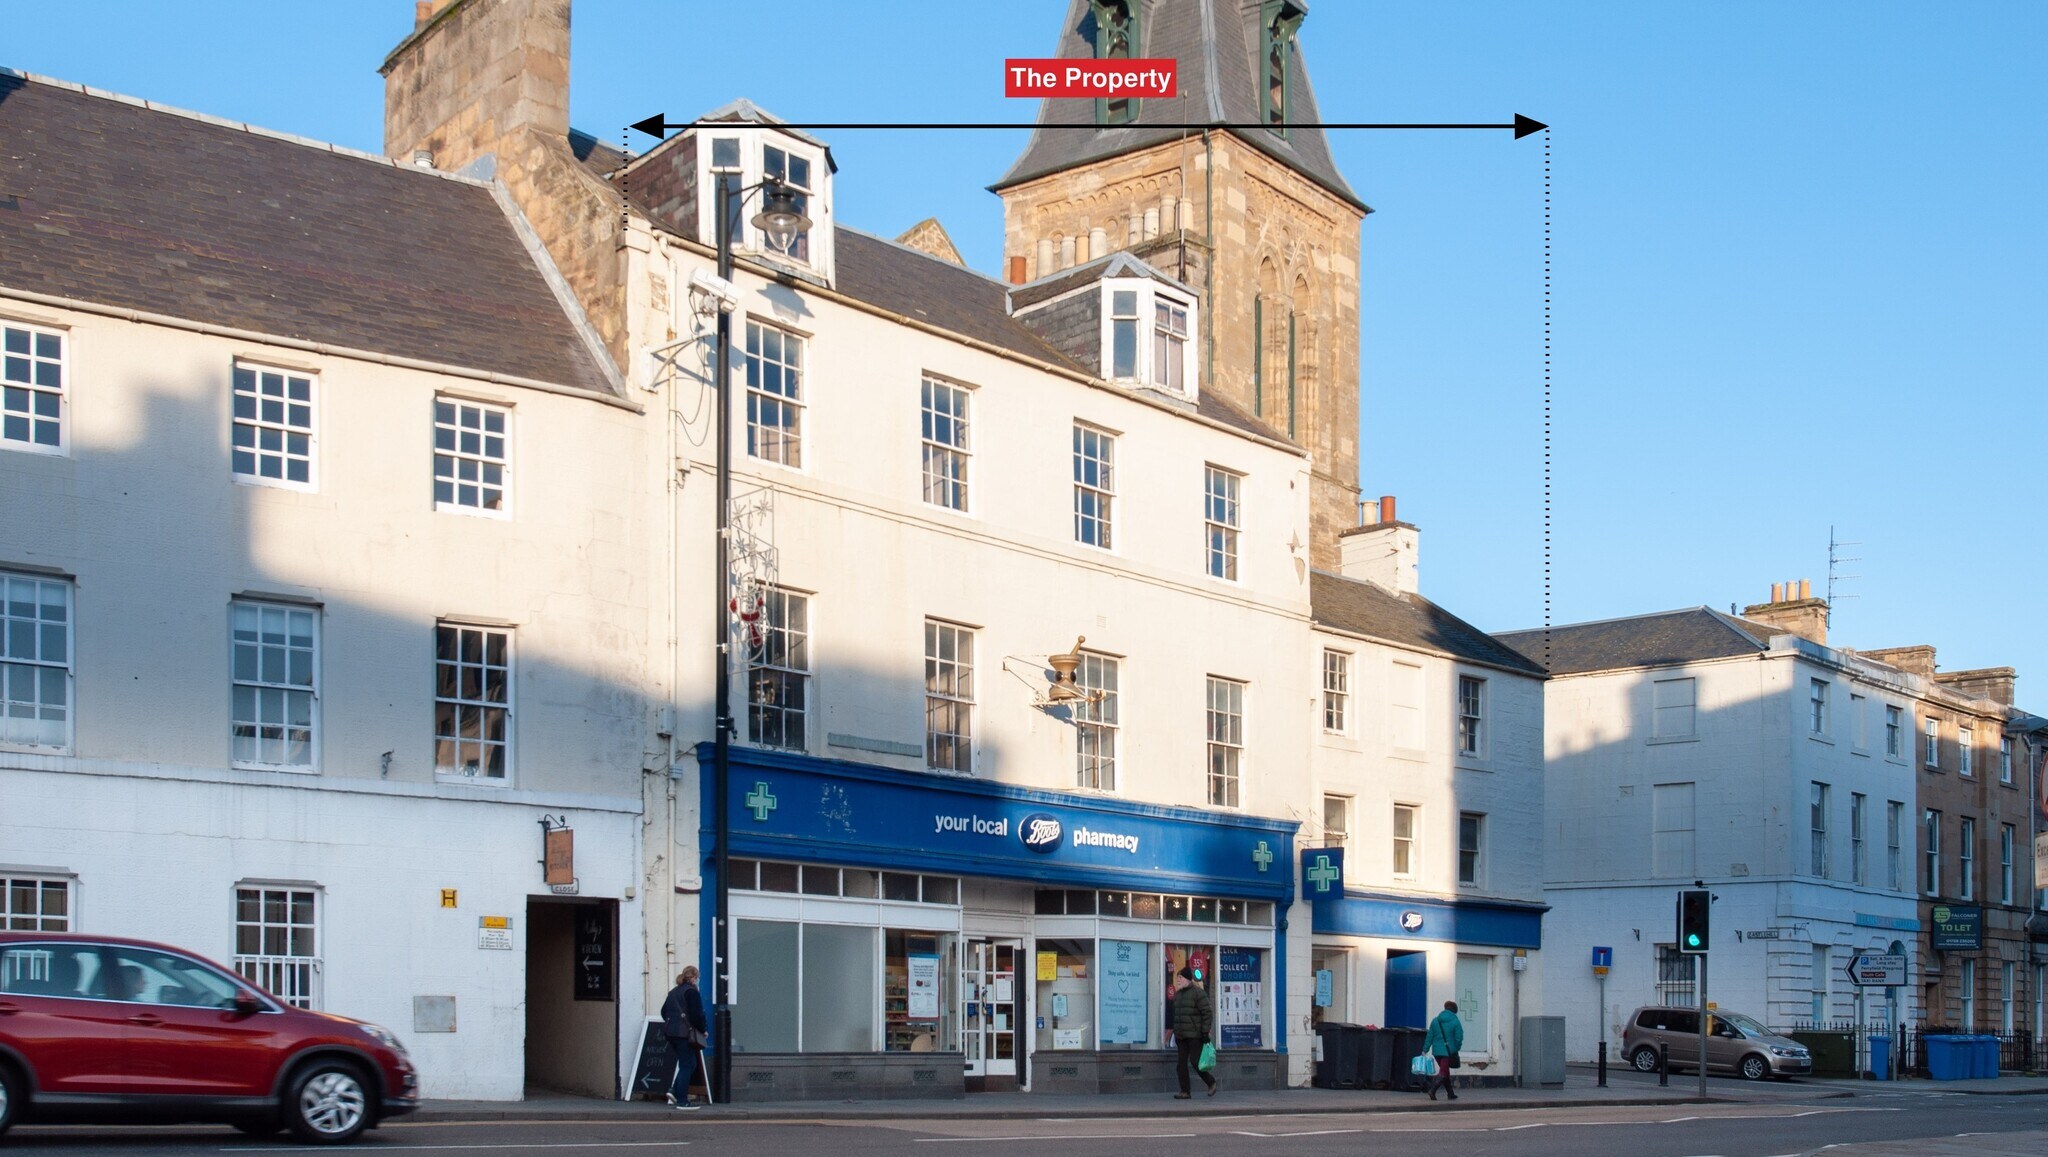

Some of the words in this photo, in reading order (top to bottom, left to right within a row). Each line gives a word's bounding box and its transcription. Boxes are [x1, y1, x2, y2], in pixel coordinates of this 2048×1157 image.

[935, 815, 969, 833] your
[973, 814, 1008, 836] local
[1026, 819, 1061, 845] Boots
[1073, 826, 1139, 853] pharmacy
[1117, 942, 1131, 951] Shop
[1117, 950, 1130, 959] Safe
